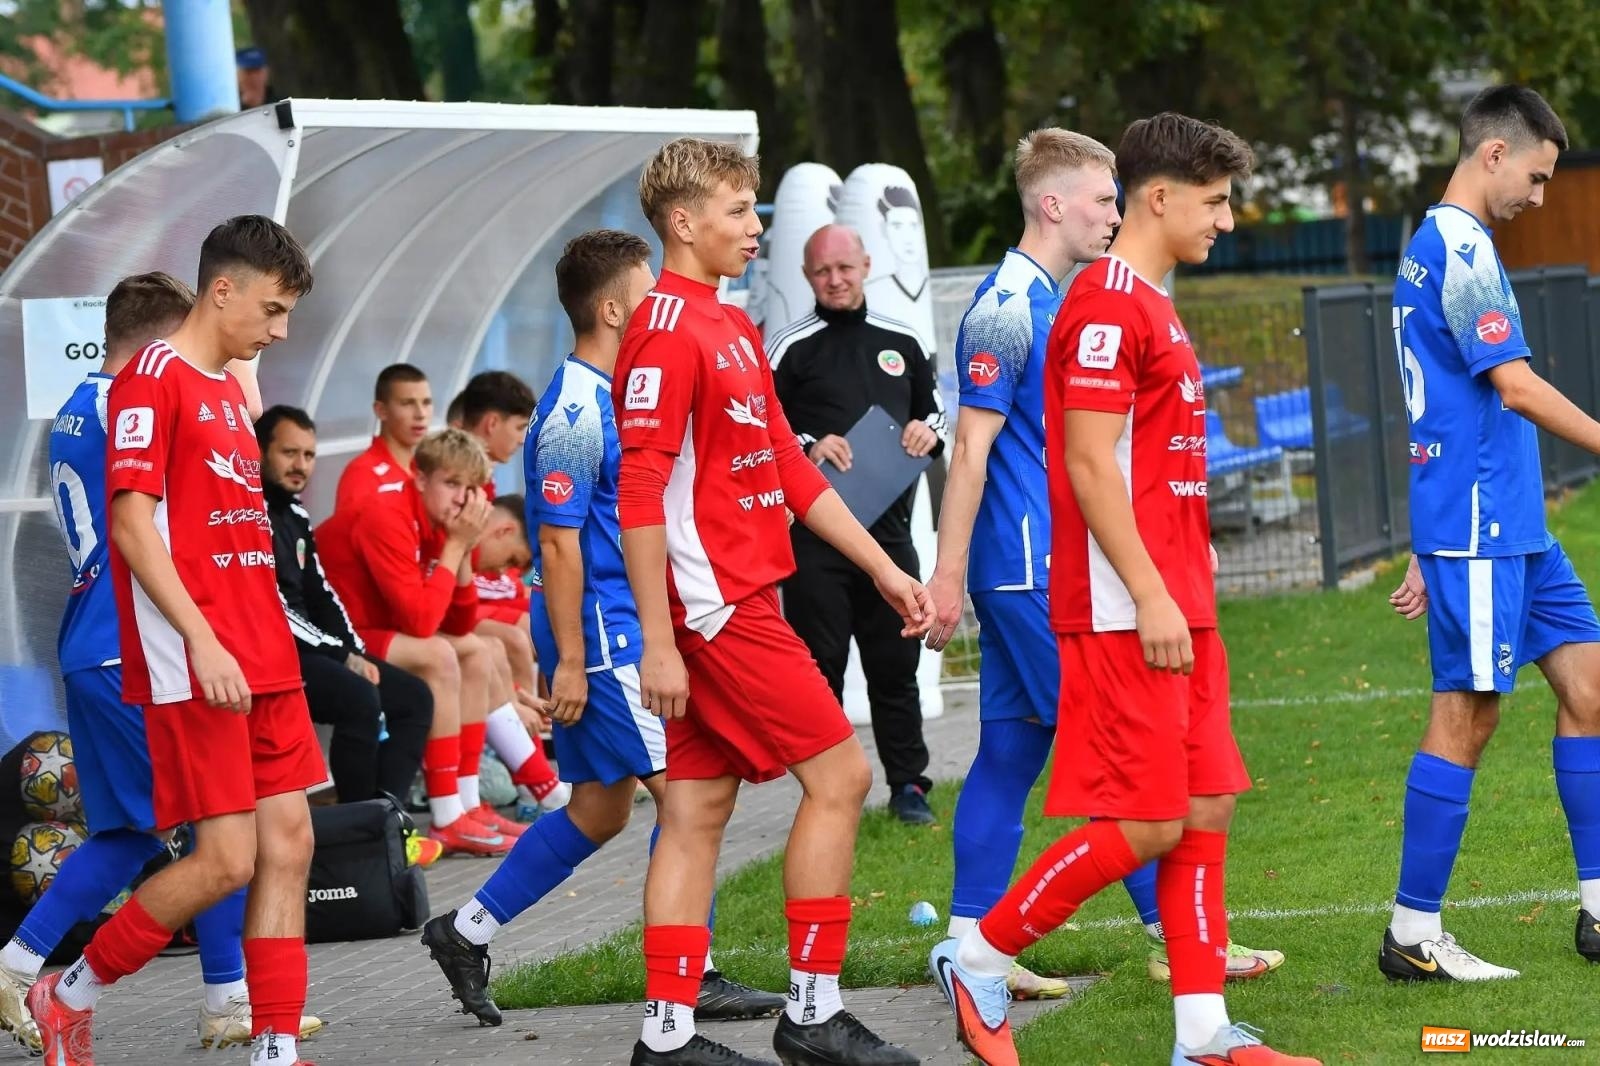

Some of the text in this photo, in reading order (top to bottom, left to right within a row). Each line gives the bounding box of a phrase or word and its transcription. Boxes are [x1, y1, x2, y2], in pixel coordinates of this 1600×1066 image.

[1092, 355, 1109, 363] LIGA
[968, 361, 1000, 378] RV
[634, 396, 649, 404] LIGA
[127, 435, 145, 443] LIGA
[541, 479, 574, 497] RV
